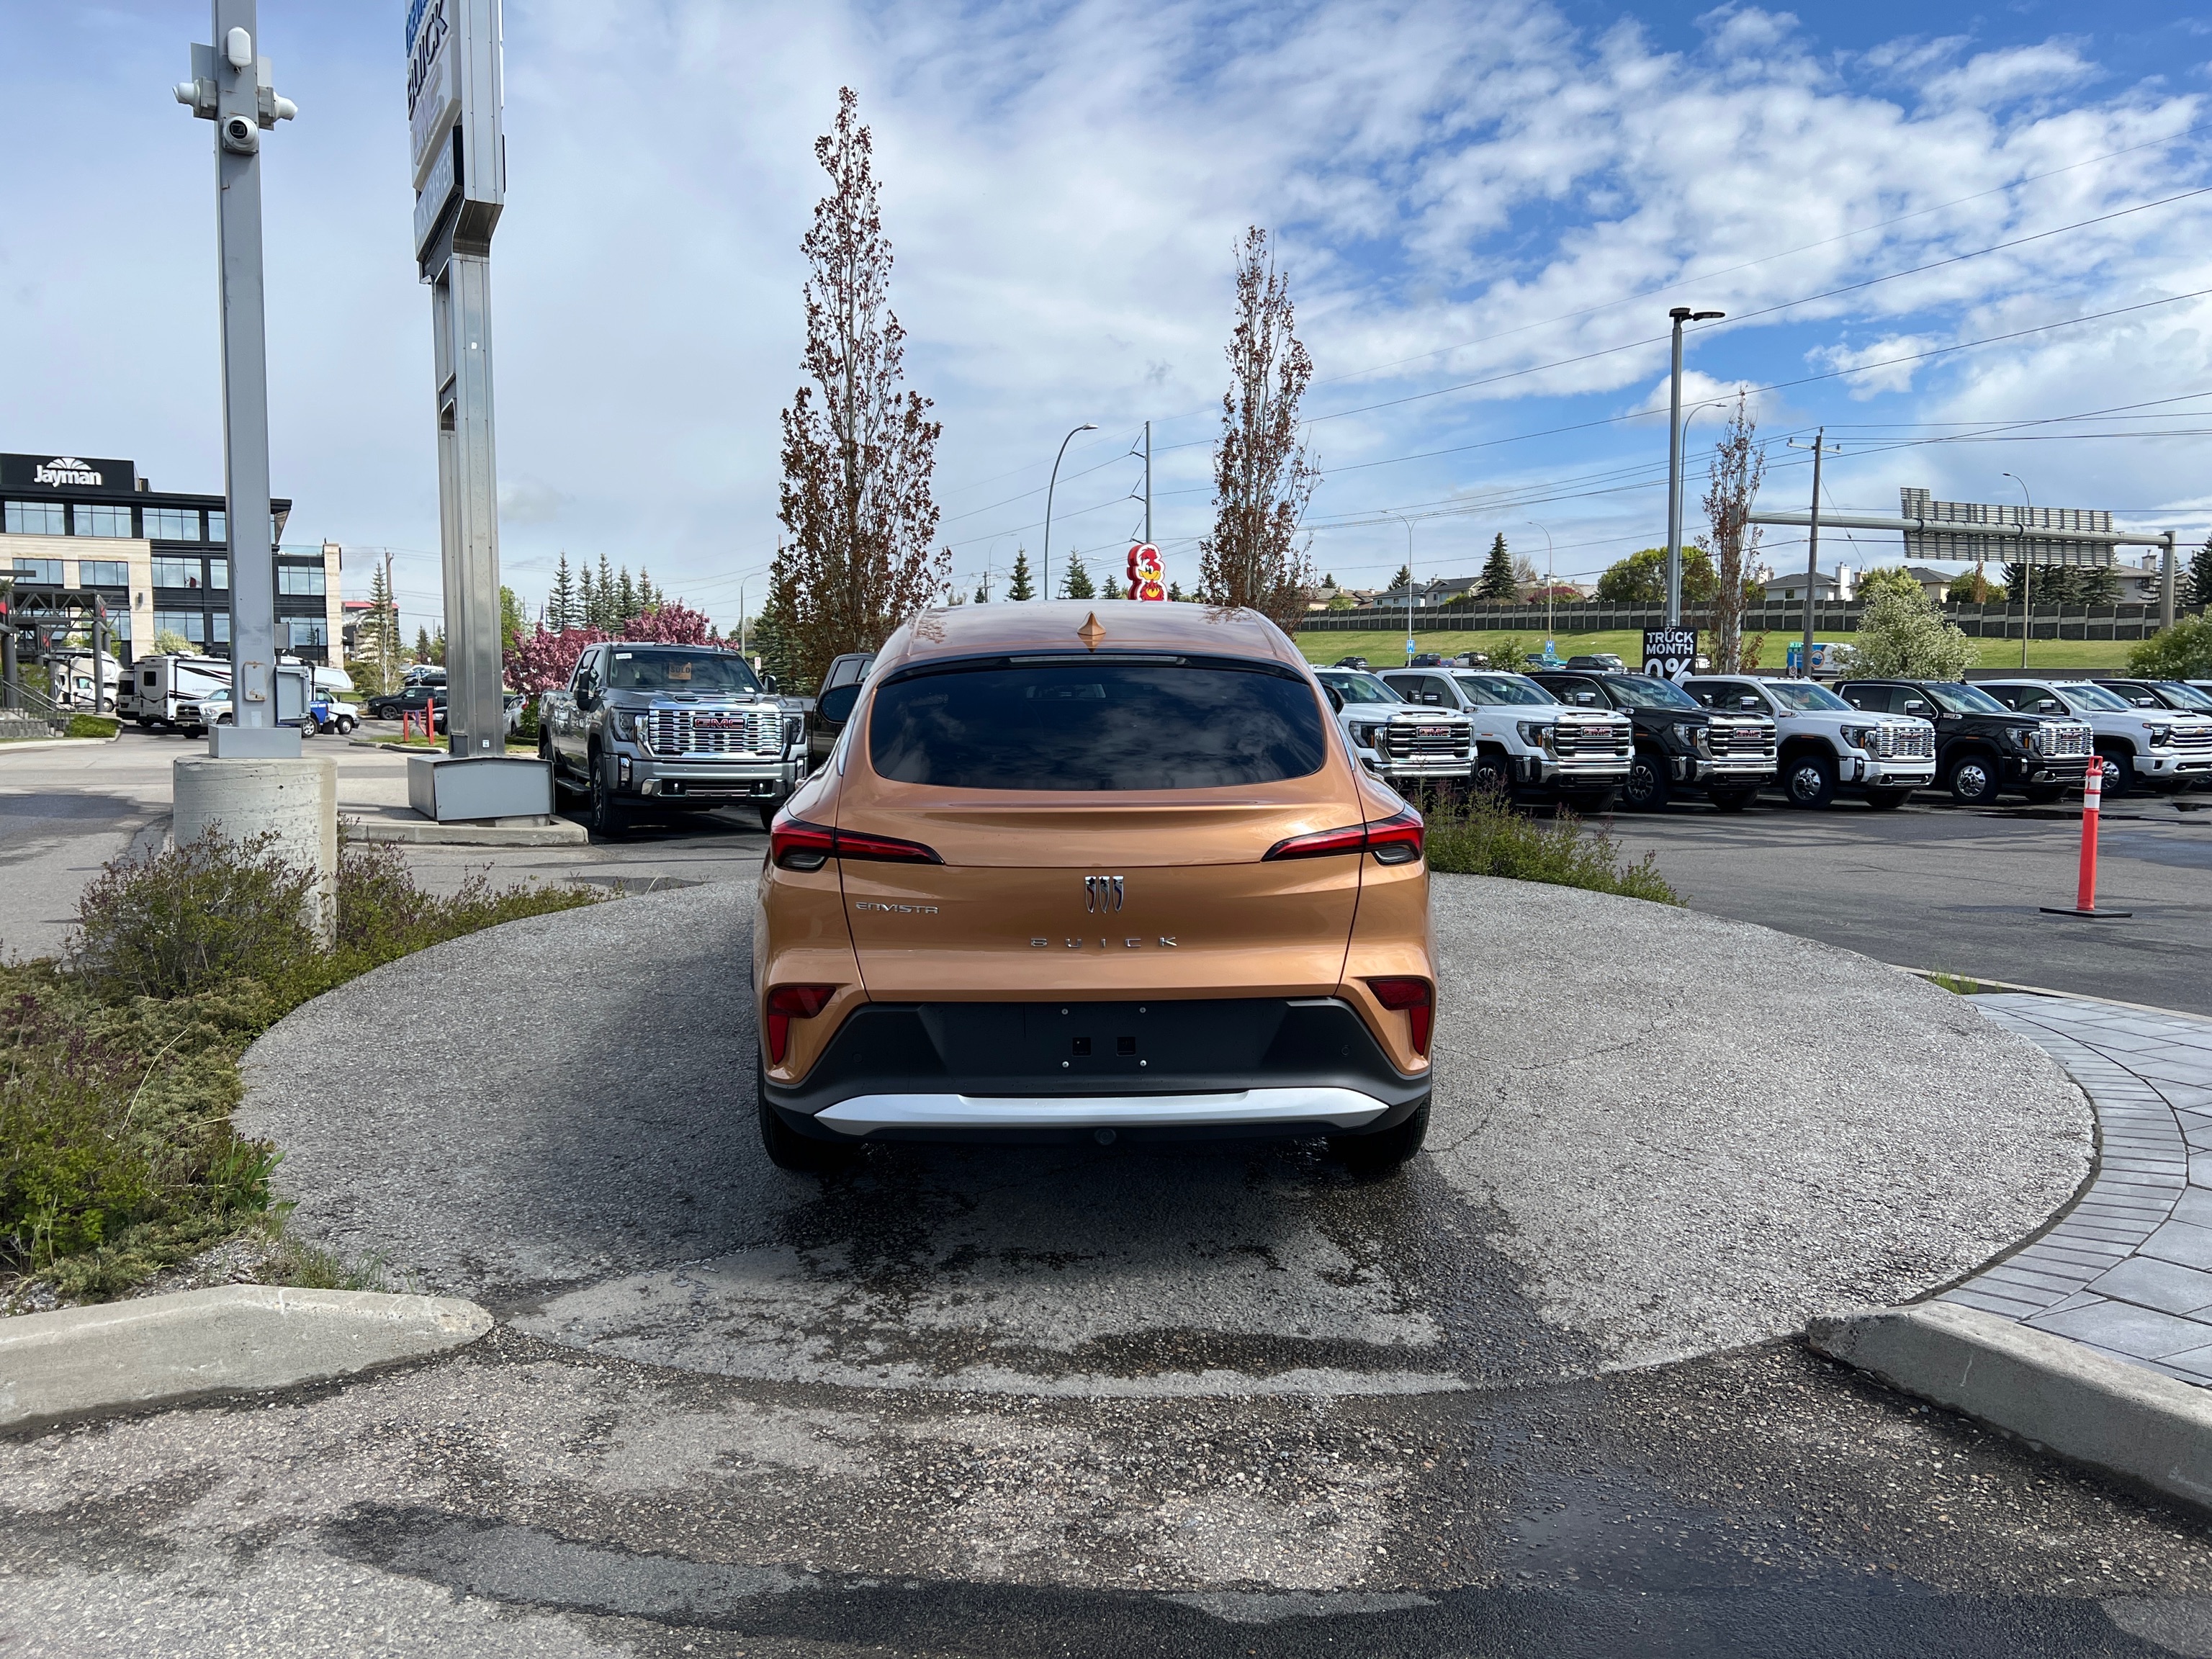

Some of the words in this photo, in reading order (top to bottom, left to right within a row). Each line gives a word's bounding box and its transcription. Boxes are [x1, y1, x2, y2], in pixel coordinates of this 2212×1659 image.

[428, 144, 452, 217] CARTER
[33, 464, 102, 487] Jayman
[1647, 631, 1694, 644] TRUCK
[1646, 643, 1693, 655] MONTH
[1645, 657, 1692, 681] 0%
[694, 718, 745, 729] GMC
[1419, 728, 1450, 737] GMC
[855, 902, 938, 914] ENVISTA
[1030, 937, 1177, 948] BUICK
